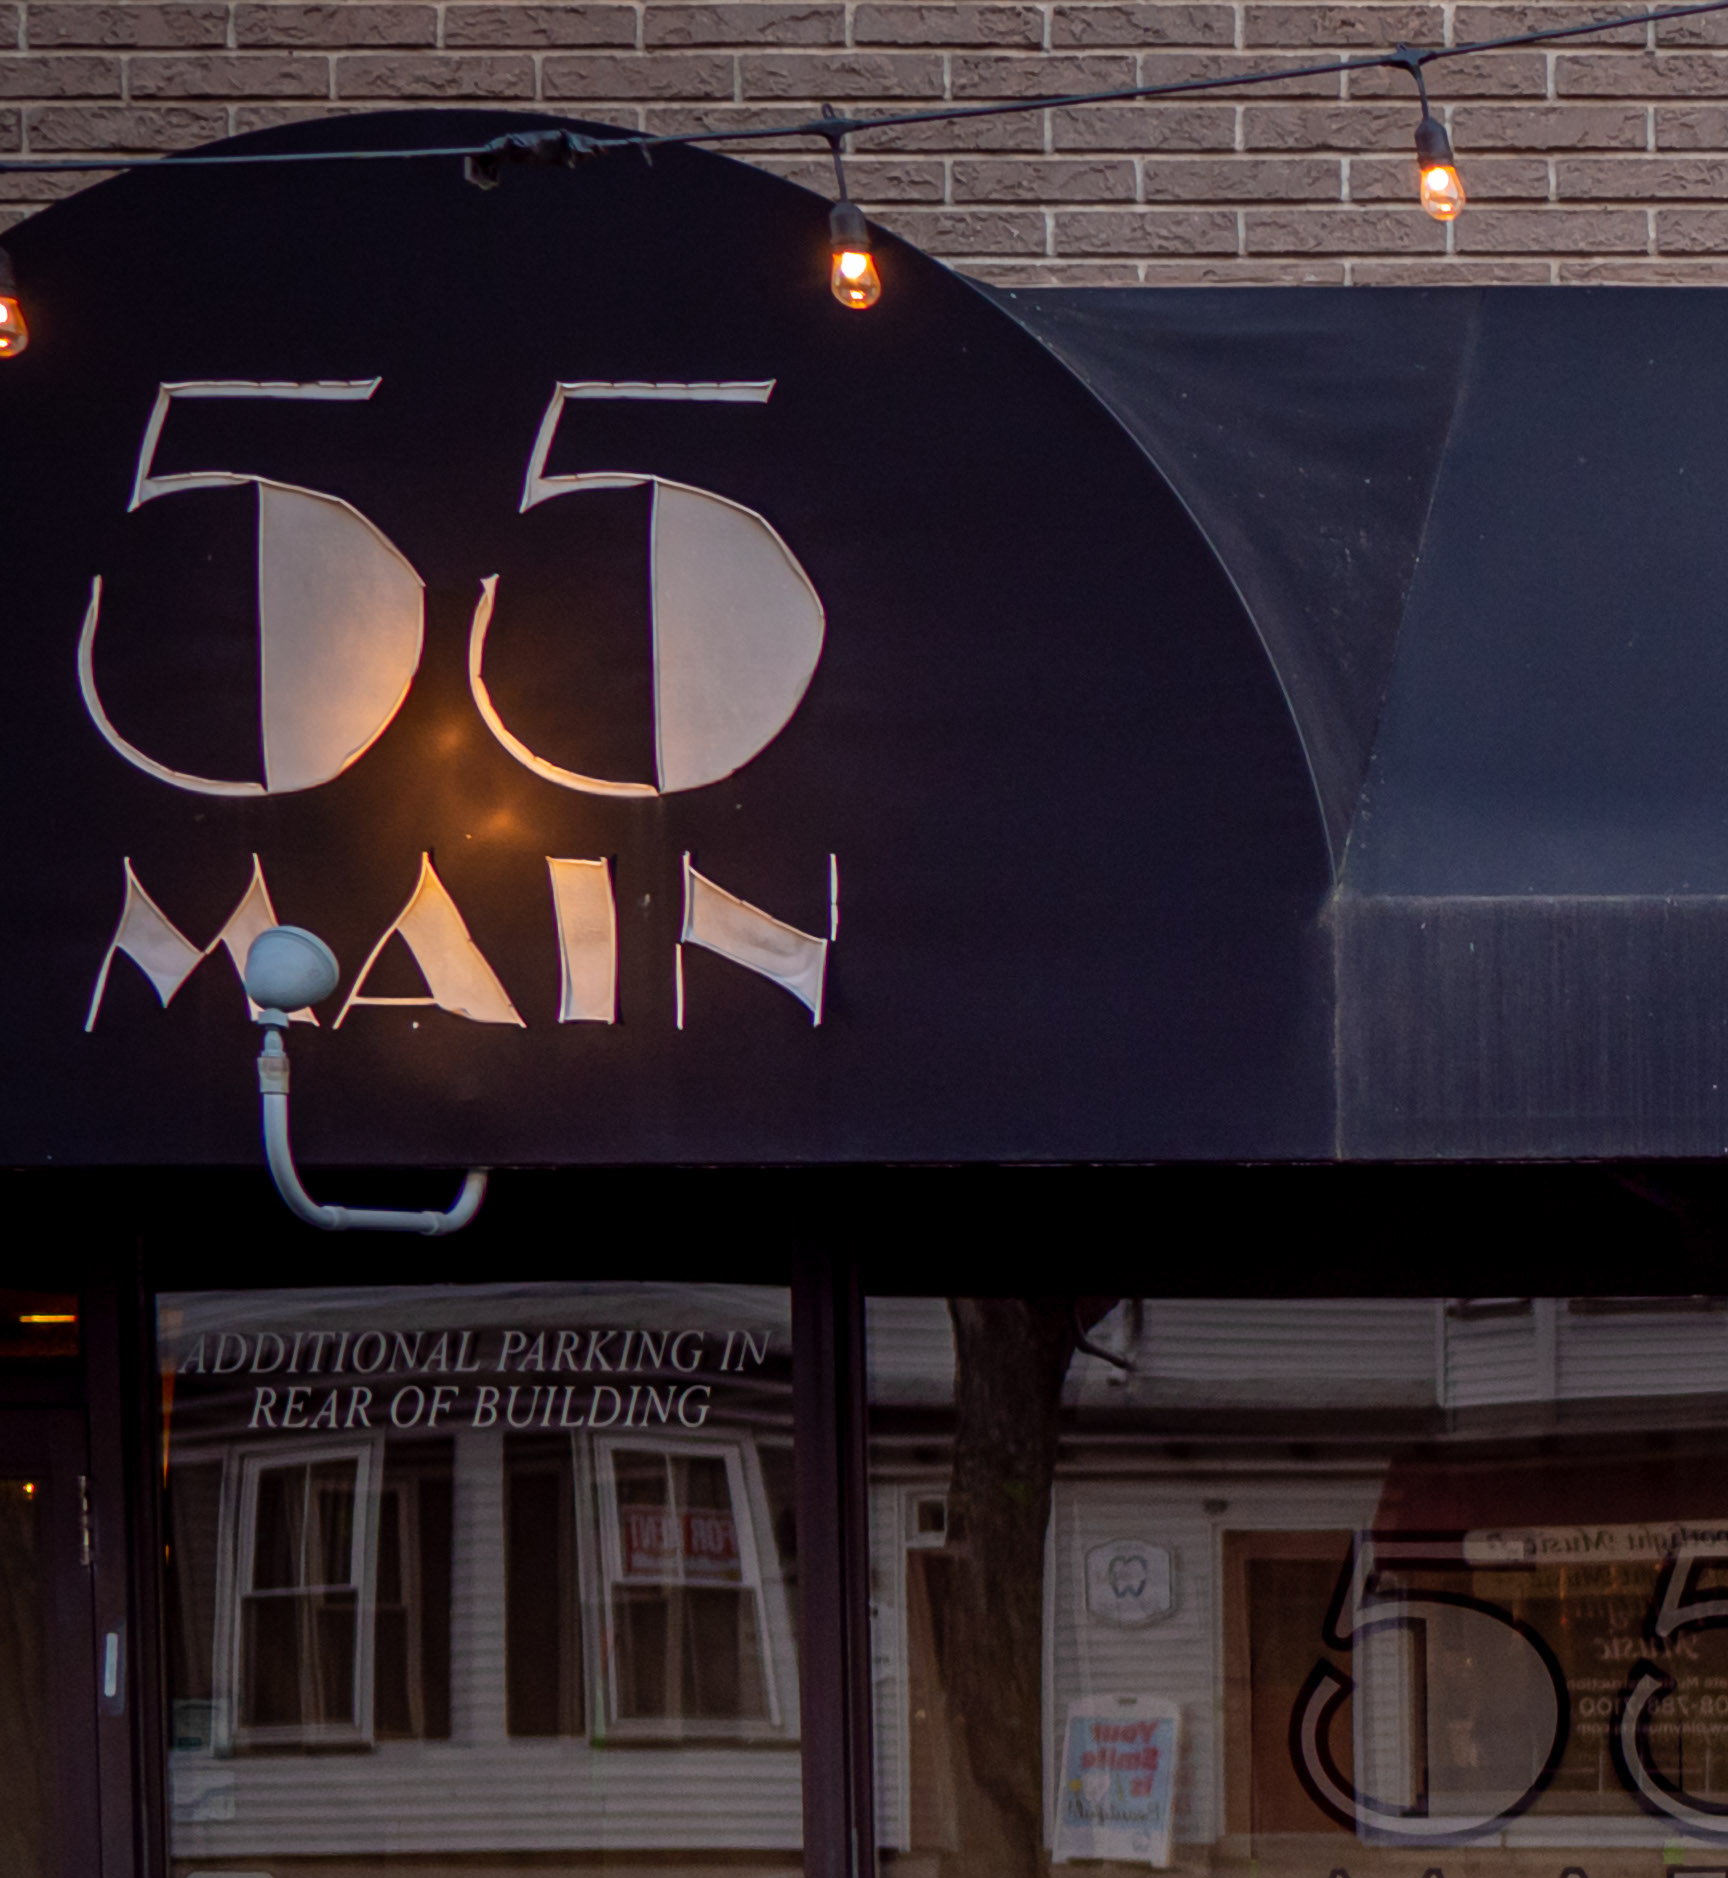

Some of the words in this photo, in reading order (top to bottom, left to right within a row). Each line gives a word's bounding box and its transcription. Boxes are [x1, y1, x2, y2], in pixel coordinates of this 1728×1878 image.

[77, 376, 826, 798] 55
[84, 850, 839, 1032] MAIN
[180, 1330, 481, 1375] ADDITIONAL
[496, 1330, 704, 1373] PARKING
[720, 1330, 771, 1372] IN
[248, 1385, 373, 1429] REAR
[390, 1385, 459, 1428] OF
[472, 1384, 712, 1429] BUILDING
